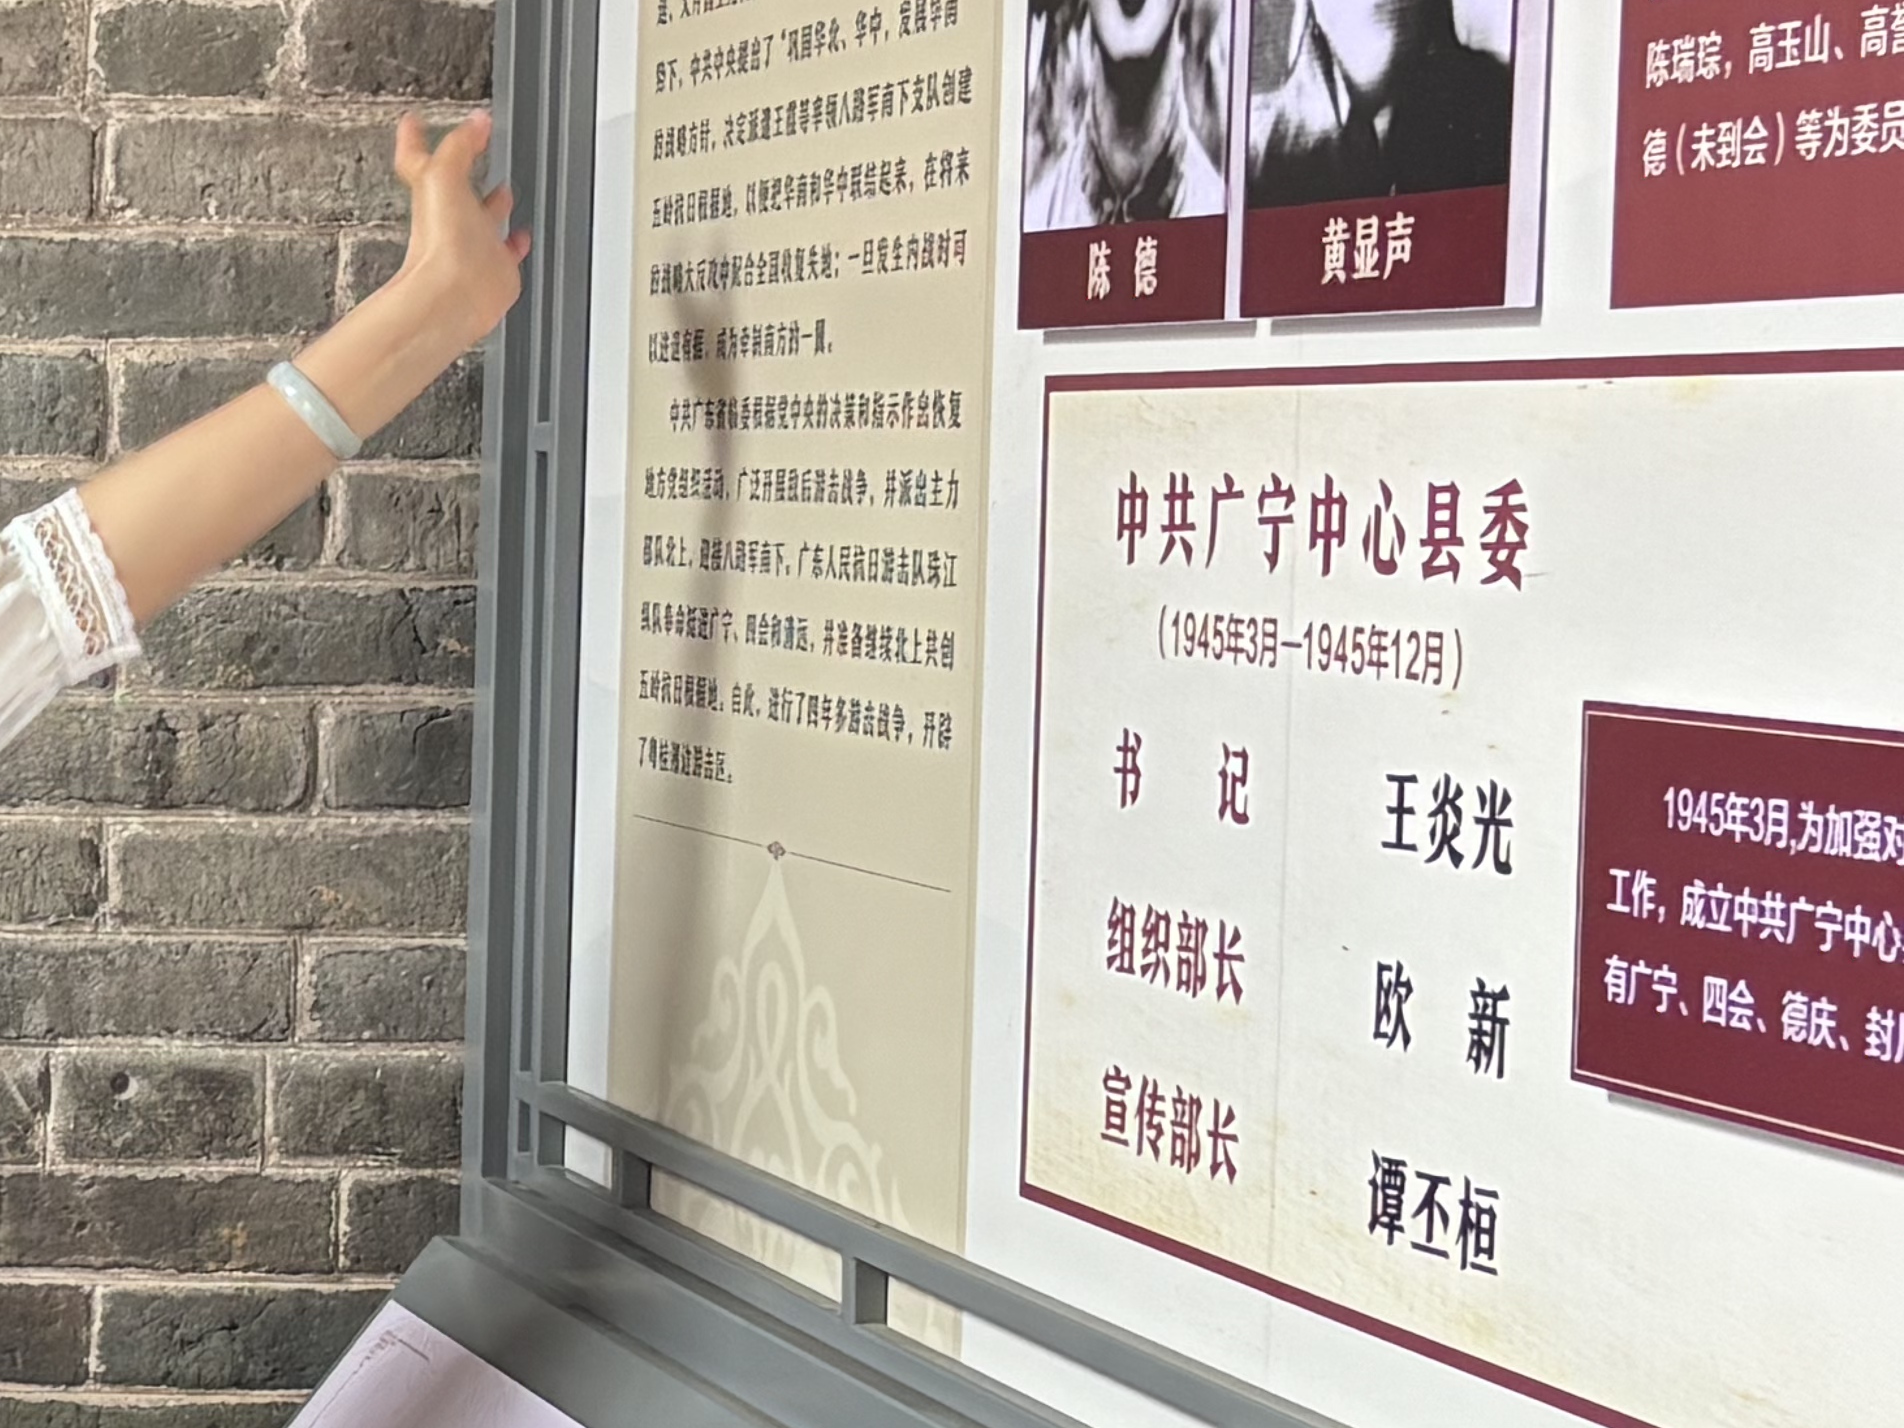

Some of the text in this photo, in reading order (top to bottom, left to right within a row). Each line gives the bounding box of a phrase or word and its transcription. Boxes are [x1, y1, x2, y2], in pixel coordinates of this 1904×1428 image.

[1087, 237, 1159, 299] 陈德
[1322, 212, 1415, 285] 黄显声
[1116, 470, 1531, 591] 中共广宁中心县委
[1381, 772, 1515, 876] 王炎光
[1107, 896, 1245, 1005] 组织部长
[1606, 869, 1904, 963] 工作，成立中共广宁中心
[1101, 1065, 1240, 1185] 宣传部长
[1367, 1149, 1499, 1277] 谭丕桓
